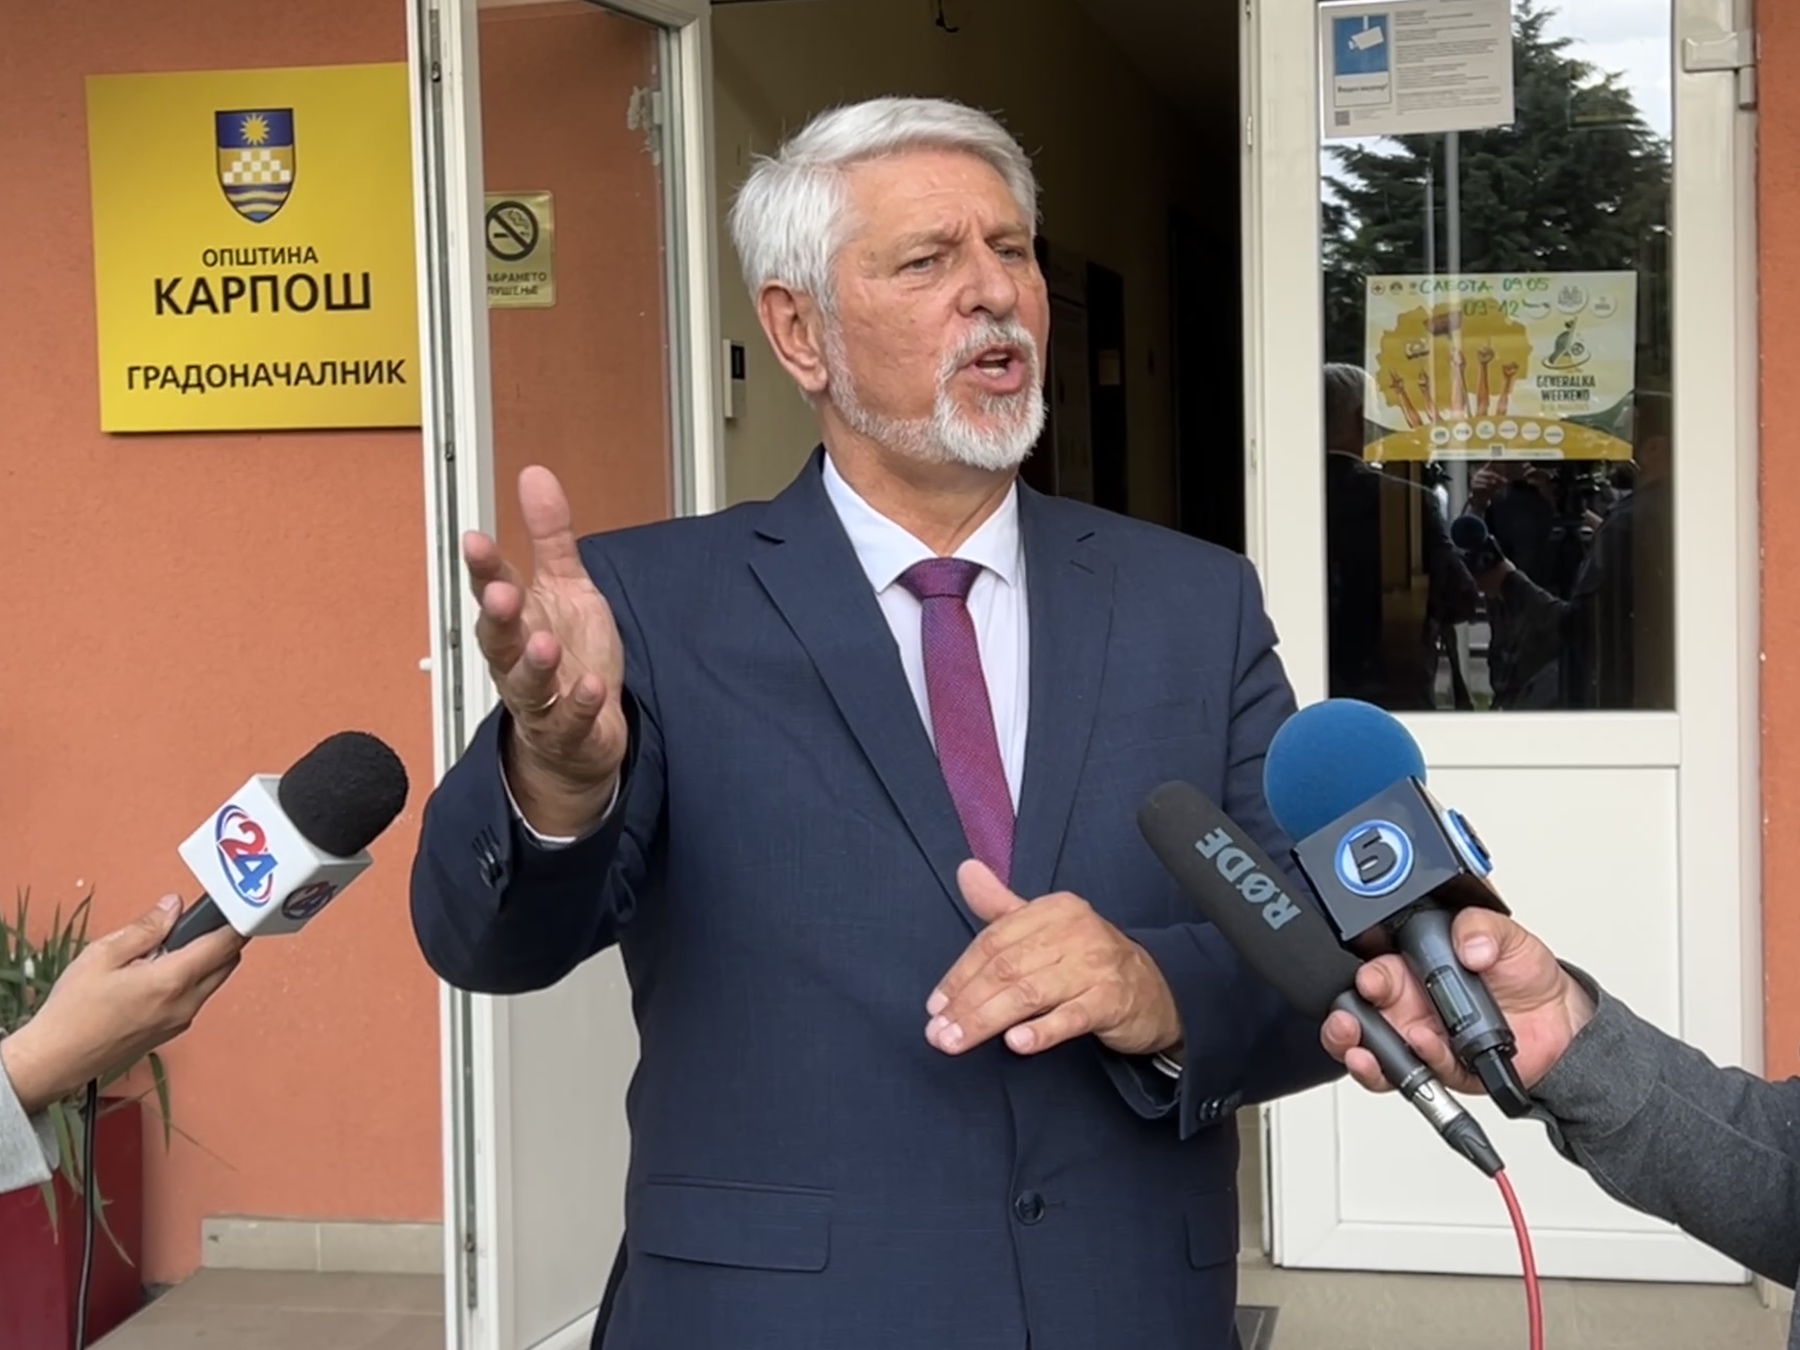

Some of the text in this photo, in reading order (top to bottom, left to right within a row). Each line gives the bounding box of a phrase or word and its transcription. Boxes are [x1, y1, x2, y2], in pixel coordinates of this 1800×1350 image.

[202, 246, 319, 267] ОПШТИНА
[154, 272, 371, 315] КАРПОШ
[487, 271, 548, 283] АБРАНЕТО
[127, 359, 406, 395] ГРАДОНАЧАЛНИК
[218, 817, 279, 895] 24
